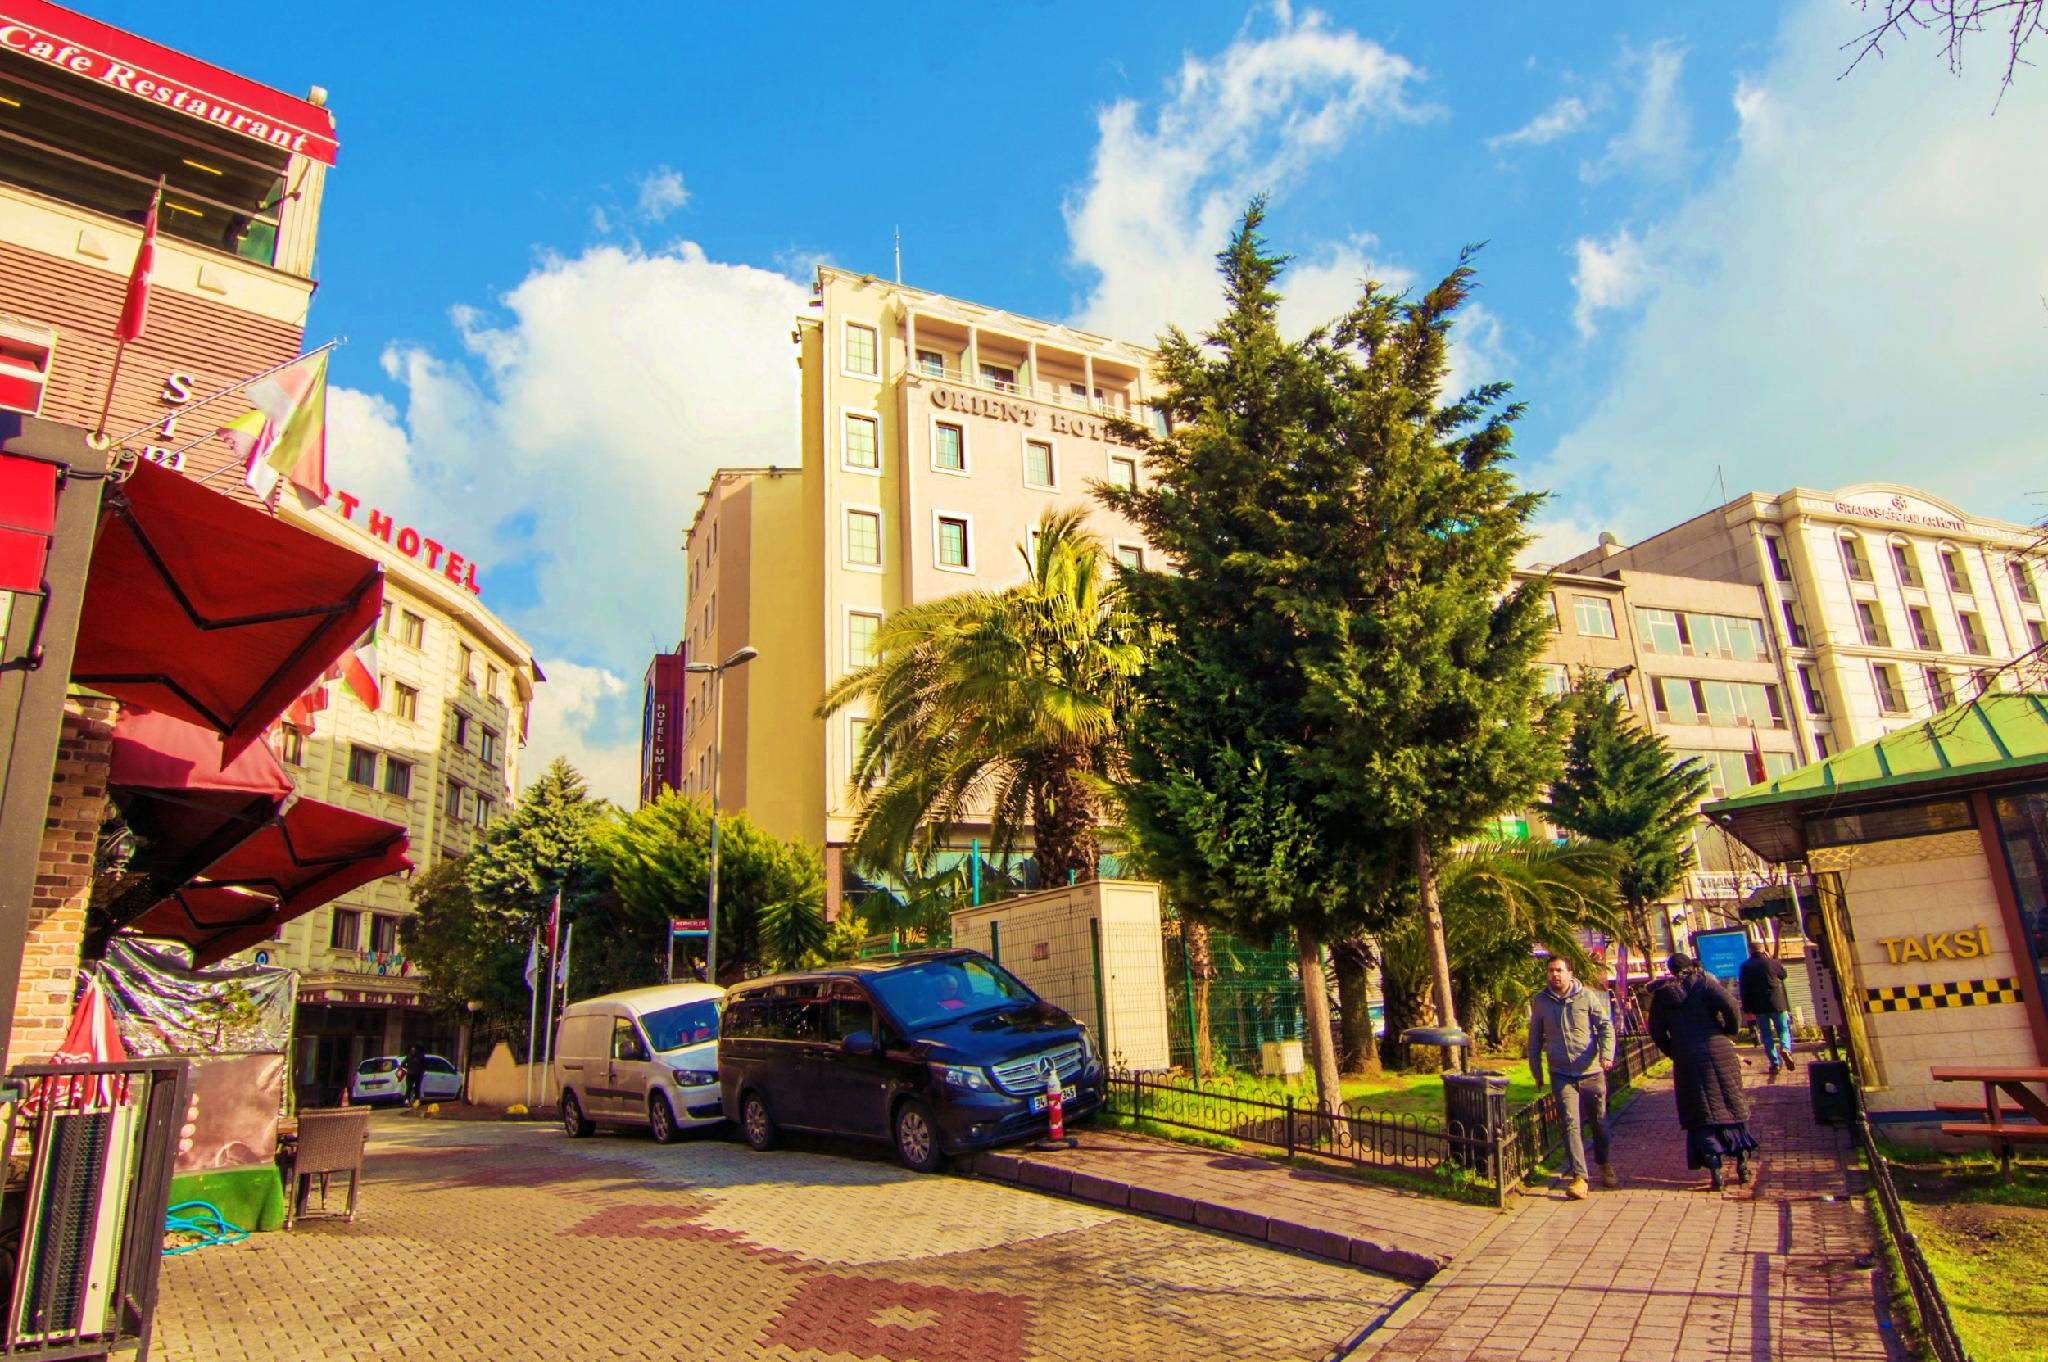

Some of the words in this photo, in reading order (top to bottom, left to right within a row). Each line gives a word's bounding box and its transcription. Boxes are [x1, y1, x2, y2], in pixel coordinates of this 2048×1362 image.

[0, 25, 93, 72] Cafe
[99, 61, 308, 152] Restaurant
[930, 387, 1036, 427] ORIENT
[368, 508, 481, 596] HOTEL
[656, 703, 665, 742] HOTEL
[1878, 922, 1991, 965] TAKSİ
